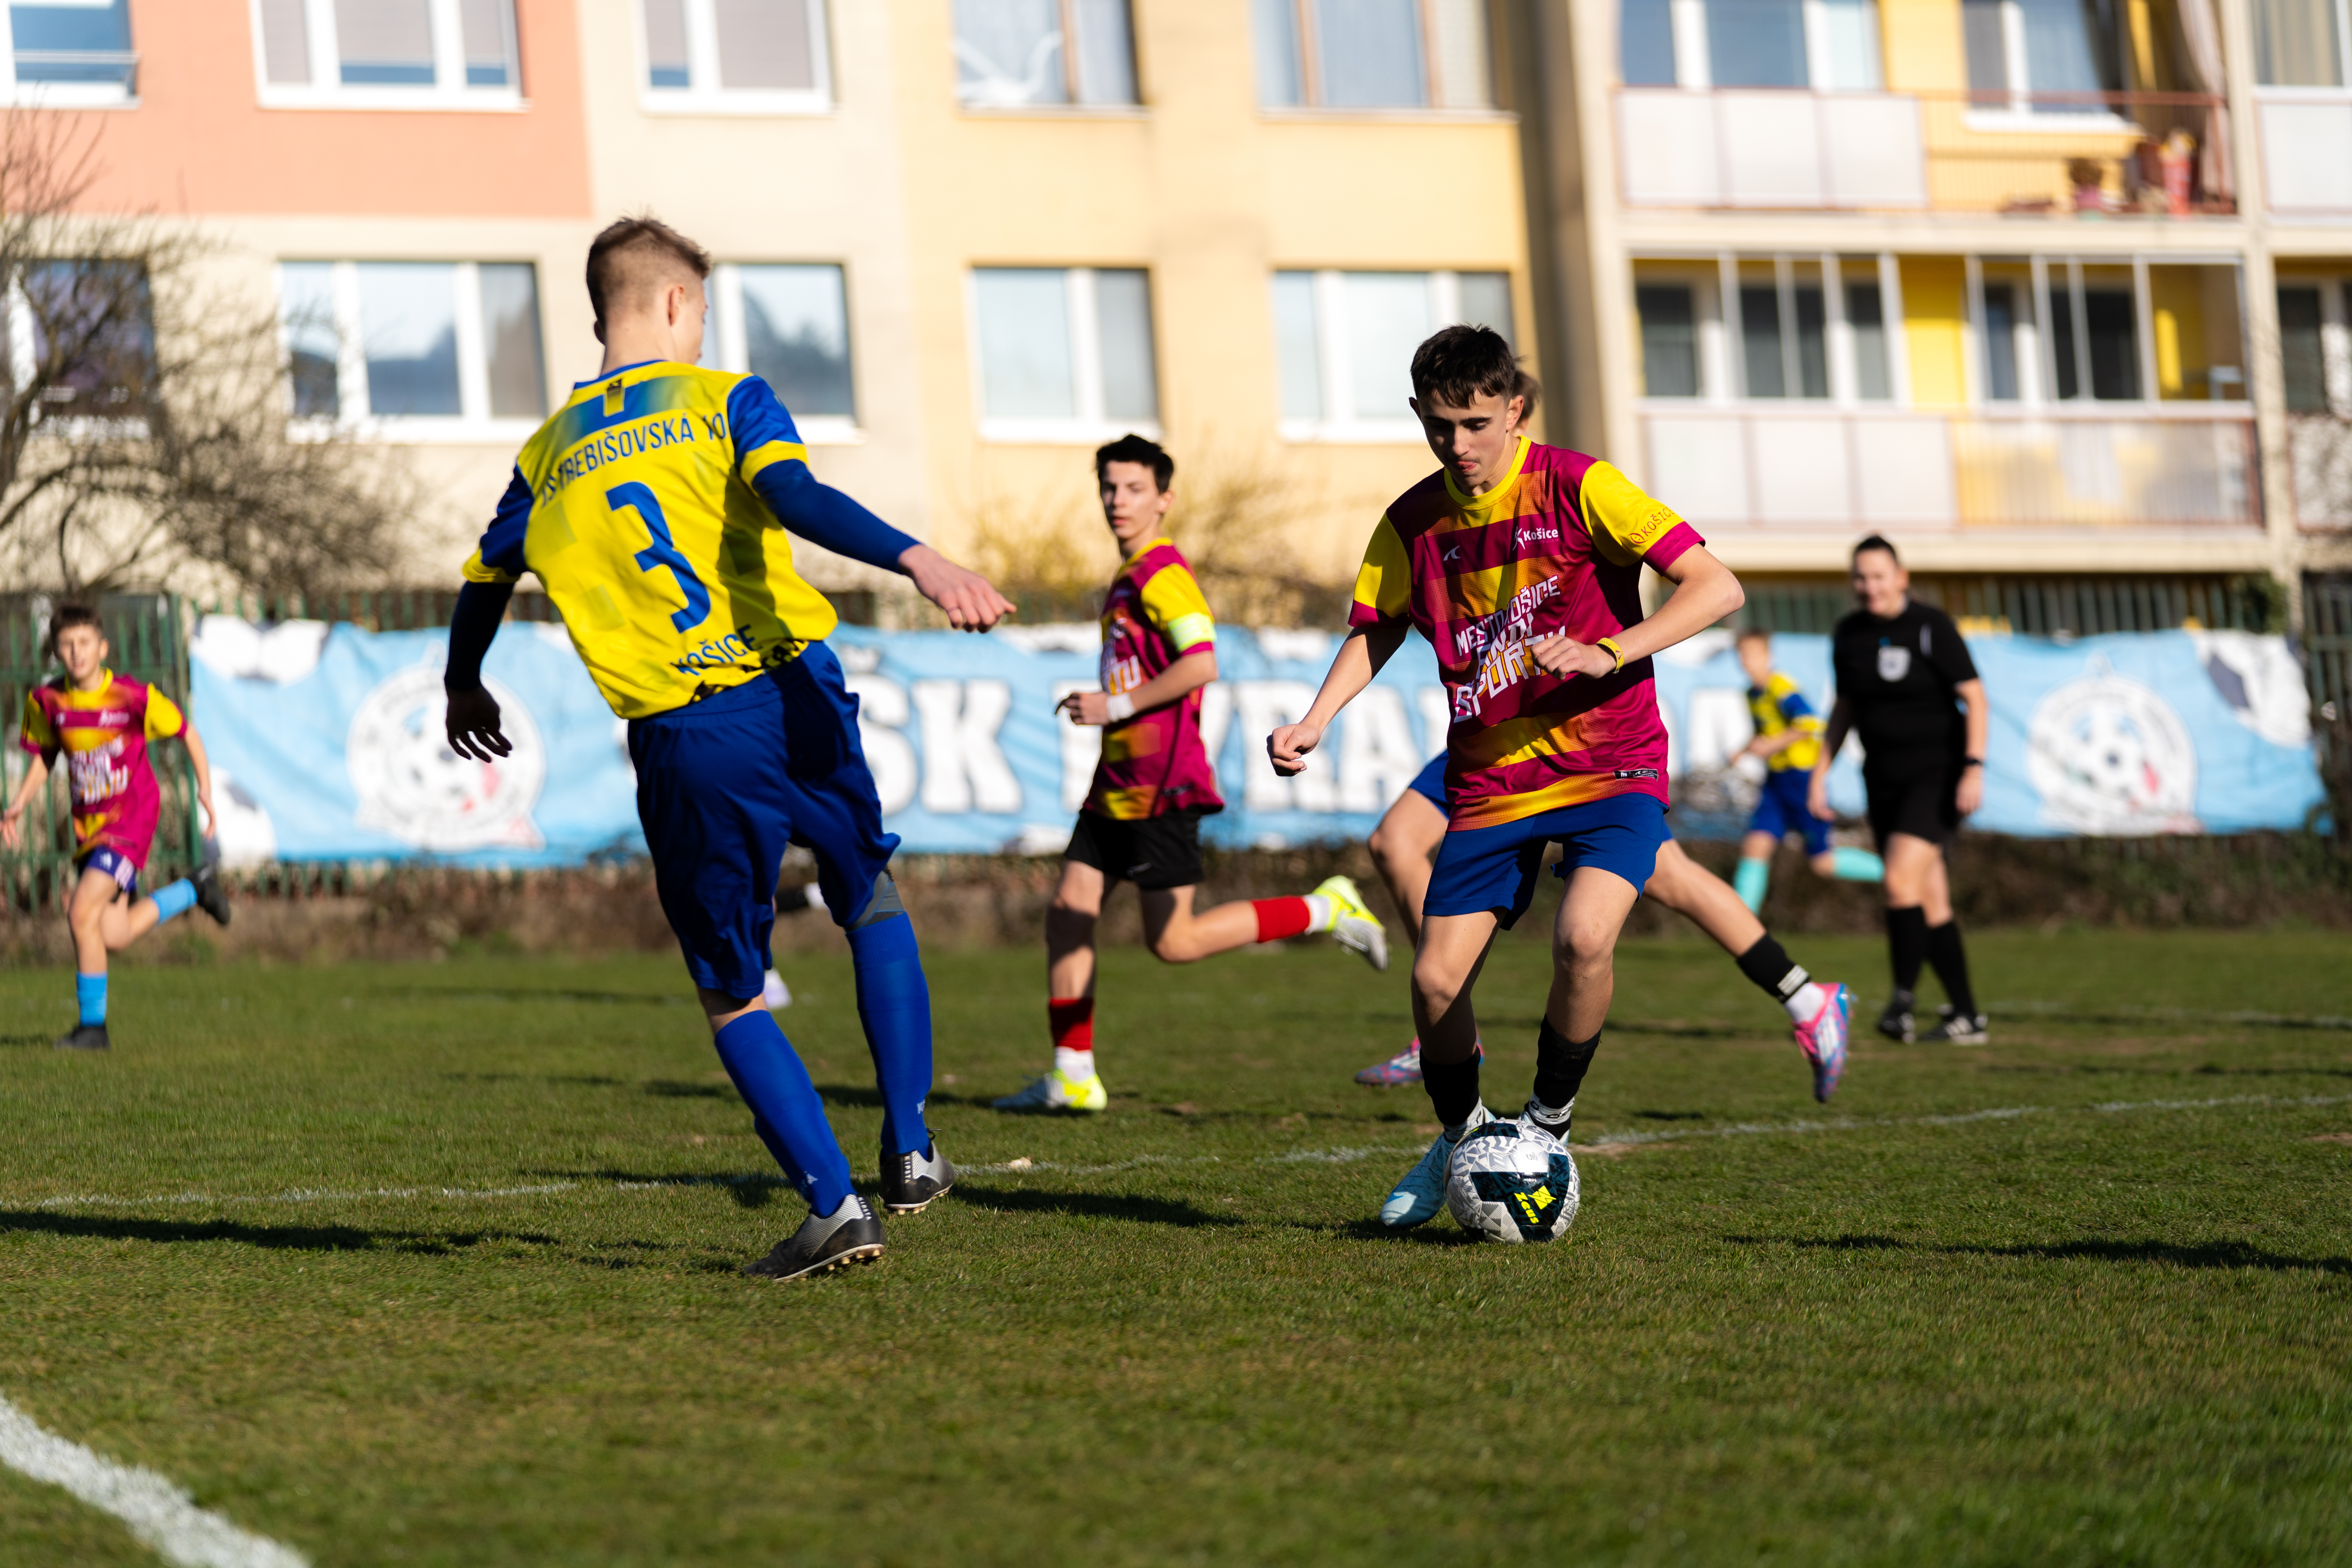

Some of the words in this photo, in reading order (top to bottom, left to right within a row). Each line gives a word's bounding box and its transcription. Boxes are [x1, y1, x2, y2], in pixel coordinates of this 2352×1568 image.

[1523, 527, 1559, 541] Košice
[605, 481, 711, 634] 3
[670, 624, 762, 676] KOŠICE
[1456, 610, 1504, 657] MESTO
[857, 1197, 873, 1221] KIPSTA
[1514, 1192, 1539, 1224] zeus
